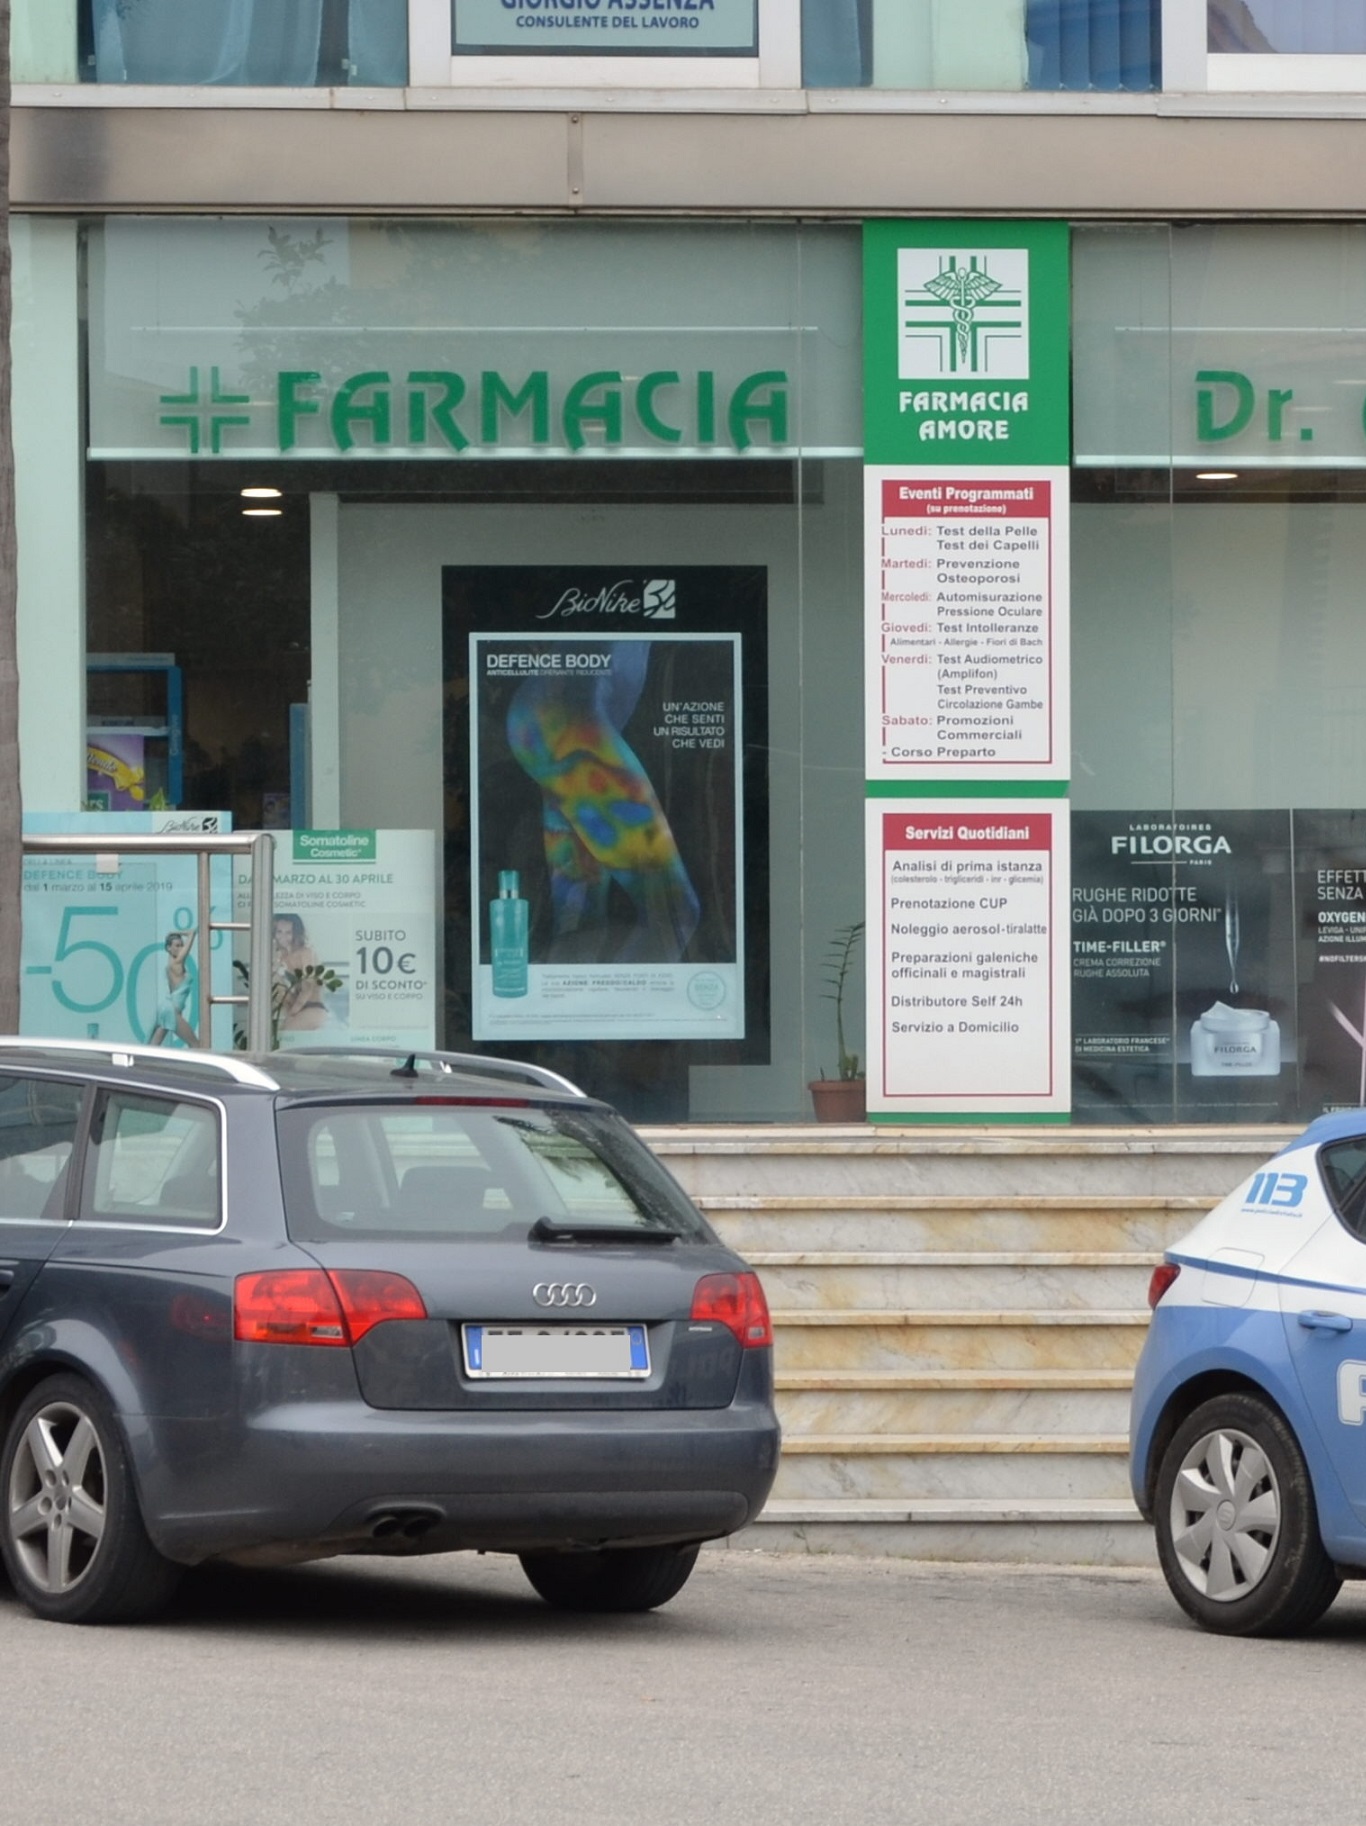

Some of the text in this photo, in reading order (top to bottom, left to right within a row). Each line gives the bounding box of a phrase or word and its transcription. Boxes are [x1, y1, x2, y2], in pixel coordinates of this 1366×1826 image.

[516, 16, 699, 28] CONSULENTE DEL LAVORO
[899, 391, 1028, 413] FARMACIA
[1195, 371, 1312, 441] Dr.
[277, 370, 789, 452] FARMACIA
[919, 420, 1010, 441] AMORE
[899, 487, 1033, 502] Eventi Programmati
[927, 504, 1006, 514] (su prenotazione)
[937, 526, 964, 536] Test
[969, 526, 1001, 536] della
[1005, 526, 1038, 536] Pelle
[937, 540, 1039, 552] Test dei Capelli
[937, 559, 1020, 569] Prevenzione
[937, 573, 1020, 585] Osteoporosi
[937, 592, 1042, 602] Automisurazione
[937, 606, 1043, 616] Pressione Oculare
[937, 623, 962, 633] Test
[966, 623, 1038, 633] Intolleranze
[890, 638, 1043, 647] Alimentari Allergie Fiori di Bach
[486, 654, 612, 668] DEFENCE BODY
[937, 654, 961, 664] Test
[964, 654, 1043, 664] Audiometrico
[937, 668, 998, 680] (Amplifon)
[937, 685, 1027, 695] Test Preventivo
[663, 702, 725, 712] UN'AZIONE
[937, 699, 1043, 709] Circolazione Gambe
[665, 714, 725, 725] CHE SENTI
[882, 715, 1014, 725] Sabato: Promozioni
[653, 726, 725, 737] UN RISULTATO
[937, 729, 1022, 740] Commerciali
[672, 738, 725, 749] CHE VEDI
[891, 747, 996, 759] Corso Preparto
[905, 825, 1030, 840] Servizi Quotidiani
[300, 835, 369, 847] Somatoline
[1112, 836, 1232, 854] FILORGA
[892, 860, 1042, 875] Analisi di prima istanza
[23, 870, 83, 880] DEFENCE
[272, 873, 394, 884] MARZO AL 30 APRILE
[891, 875, 937, 885] (colesterolo
[944, 875, 984, 885] trigliceridi
[51, 884, 84, 892] marzo
[100, 883, 112, 892] 15
[147, 882, 173, 892] 2019
[1072, 887, 1197, 902] RUGHE RIDOTTE
[1317, 886, 1363, 900] SENZA
[891, 897, 1008, 909] Prenotazione CUP
[1072, 906, 1098, 922] GIÀ
[1103, 909, 1146, 922] DOPO
[1150, 909, 1159, 922] 3
[355, 930, 407, 941] SUBITO
[891, 923, 949, 937] Noleggio
[1318, 935, 1344, 943] AZIONE
[891, 952, 1038, 966] Preparazioni galeniche
[1073, 958, 1161, 967] CREMA CORREZIONE
[891, 967, 1026, 982] officinali e magistrali
[1073, 969, 1150, 977] RUGHE ASSOLUTA
[356, 980, 368, 990] DI
[891, 995, 1023, 1007] Distributore Self 24h
[892, 1021, 1020, 1033] Servizio a Domicilio
[1245, 1172, 1308, 1208] 113
